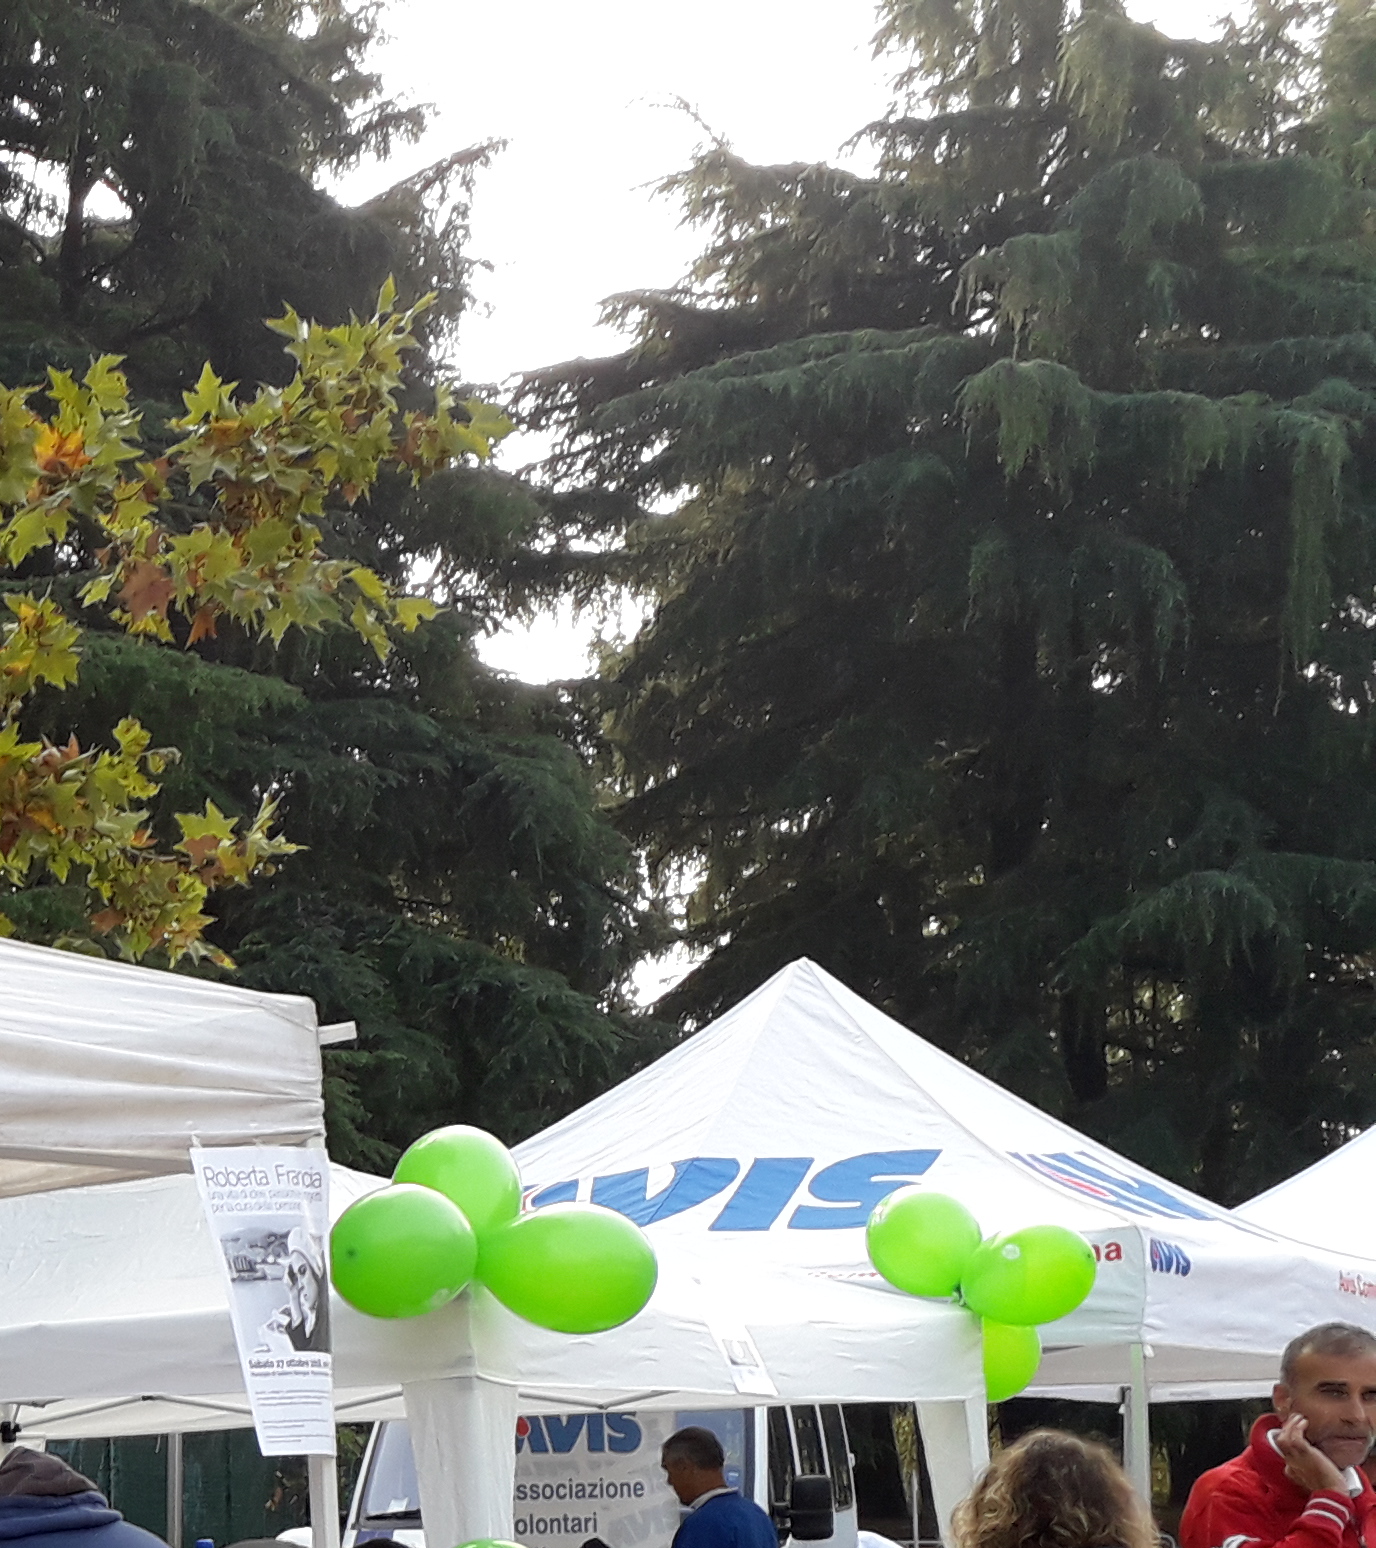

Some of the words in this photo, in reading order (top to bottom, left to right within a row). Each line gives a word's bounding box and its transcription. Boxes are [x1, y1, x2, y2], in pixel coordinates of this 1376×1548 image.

[203, 1165, 269, 1187] Roberta
[516, 1411, 643, 1454] AVIS
[516, 1478, 645, 1501] ssociazione
[515, 1512, 597, 1536] olontari
